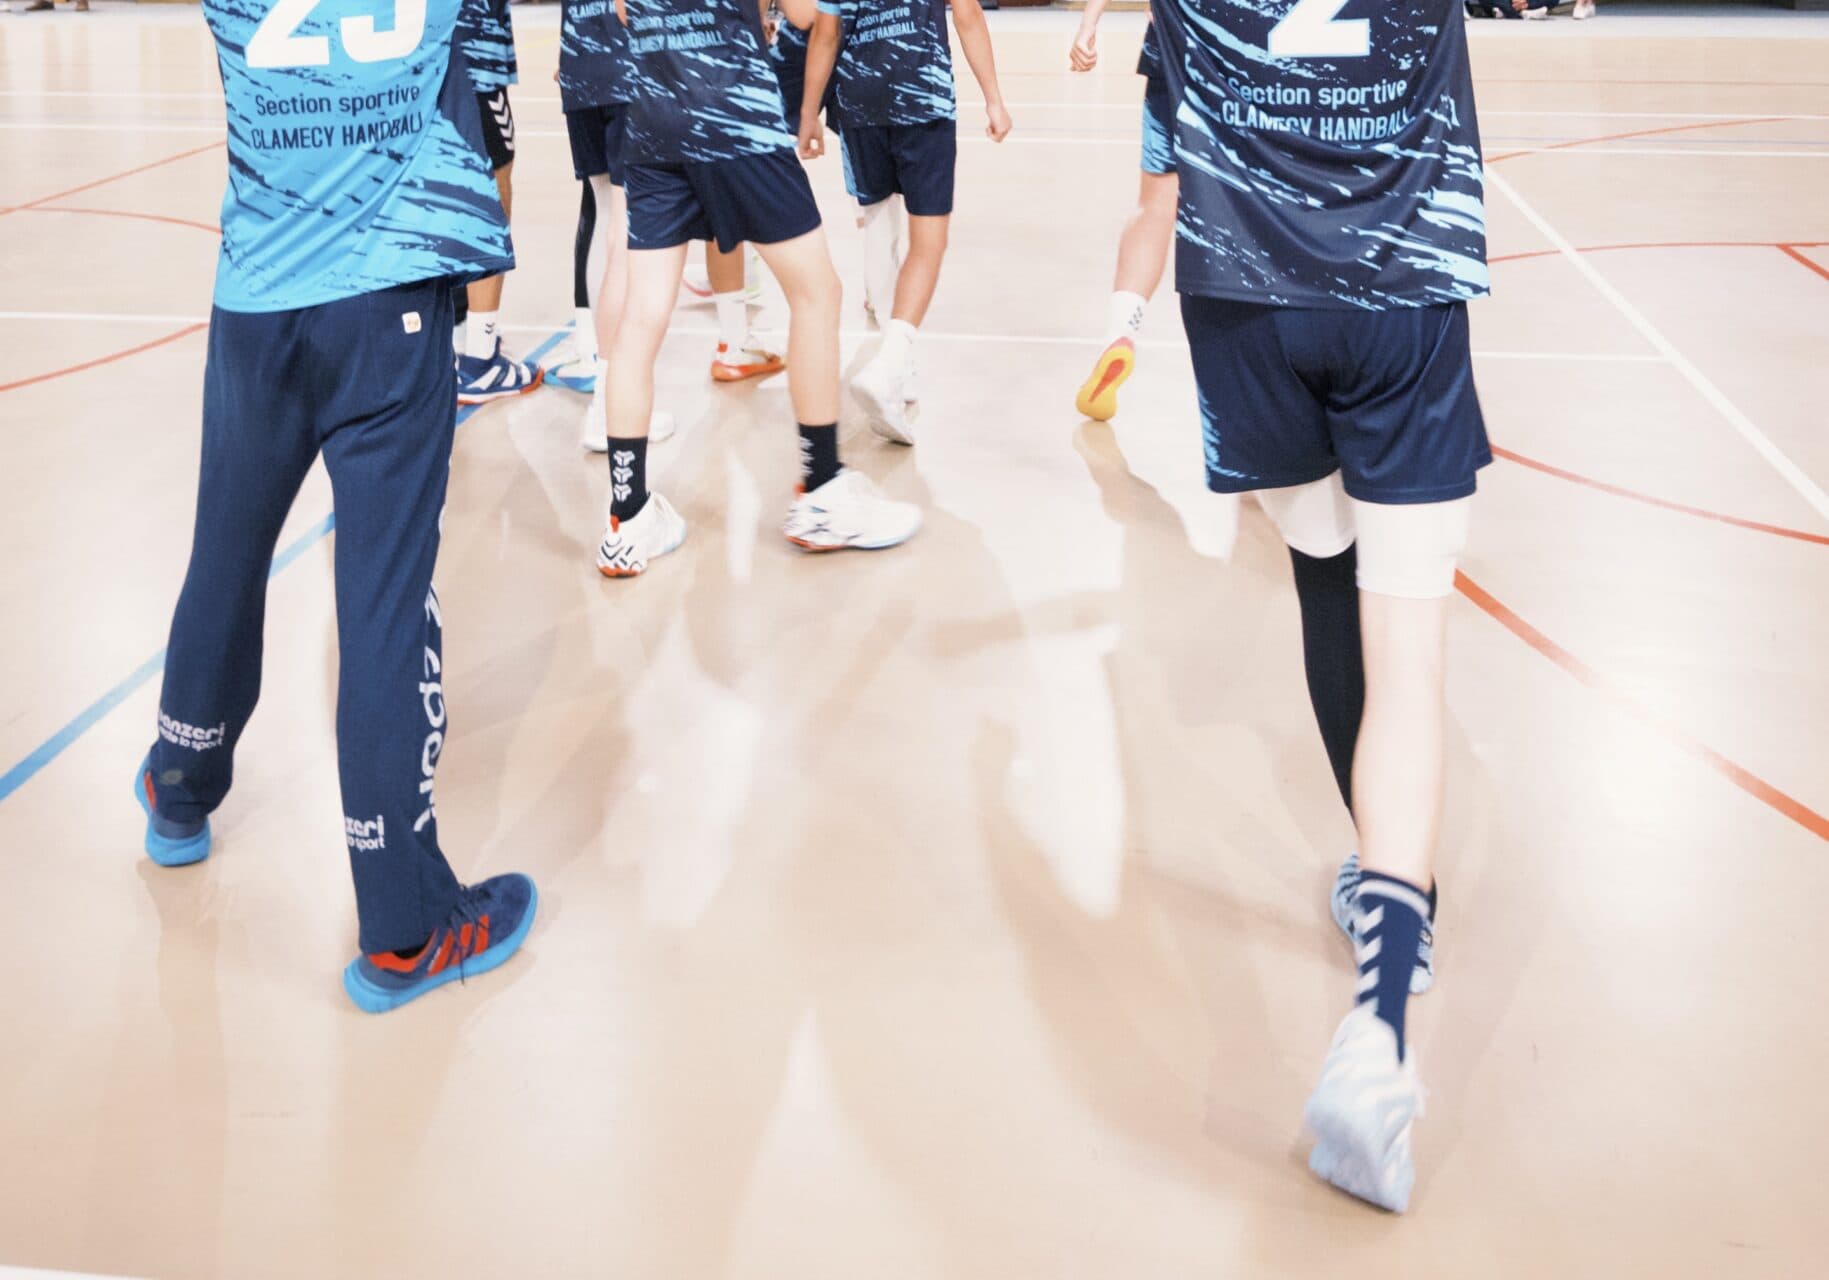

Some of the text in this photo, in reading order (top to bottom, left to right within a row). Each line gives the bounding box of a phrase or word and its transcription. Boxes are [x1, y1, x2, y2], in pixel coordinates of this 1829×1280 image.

[255, 84, 421, 117] Section sportive
[1228, 77, 1408, 110] Section sportive
[1222, 100, 1416, 141] CLAMECY HANDBALL
[251, 125, 335, 150] CLAMECY
[159, 709, 225, 741] anzeri
